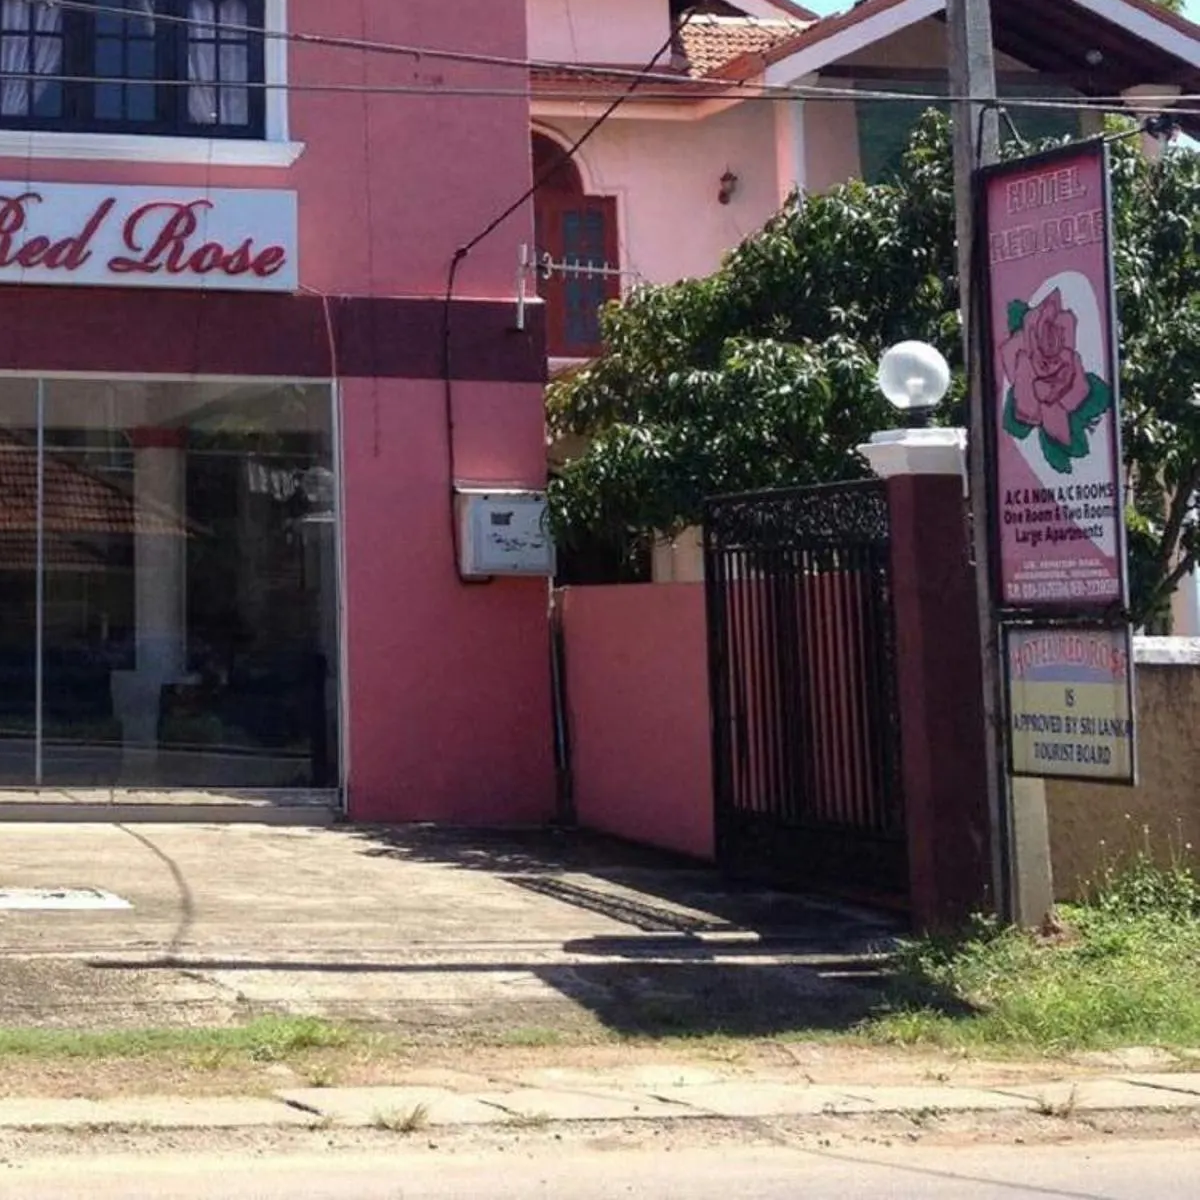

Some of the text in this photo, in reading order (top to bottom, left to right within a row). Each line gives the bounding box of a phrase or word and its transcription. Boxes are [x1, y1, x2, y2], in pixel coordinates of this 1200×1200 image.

[1006, 166, 1087, 214] HOTEL
[107, 199, 287, 278] Rose
[989, 224, 1038, 264] RED
[1031, 487, 1055, 503] NON
[1076, 482, 1113, 500] ROOMS
[1004, 509, 1023, 524] One
[1025, 507, 1053, 523] Room
[1015, 524, 1103, 548] Large Apartments
[1064, 688, 1076, 707] IS
[1013, 713, 1062, 734] APPROVED
[1065, 714, 1078, 734] BY
[1080, 715, 1096, 736] SRI
[1034, 741, 1112, 765] TOURIST BOARD
